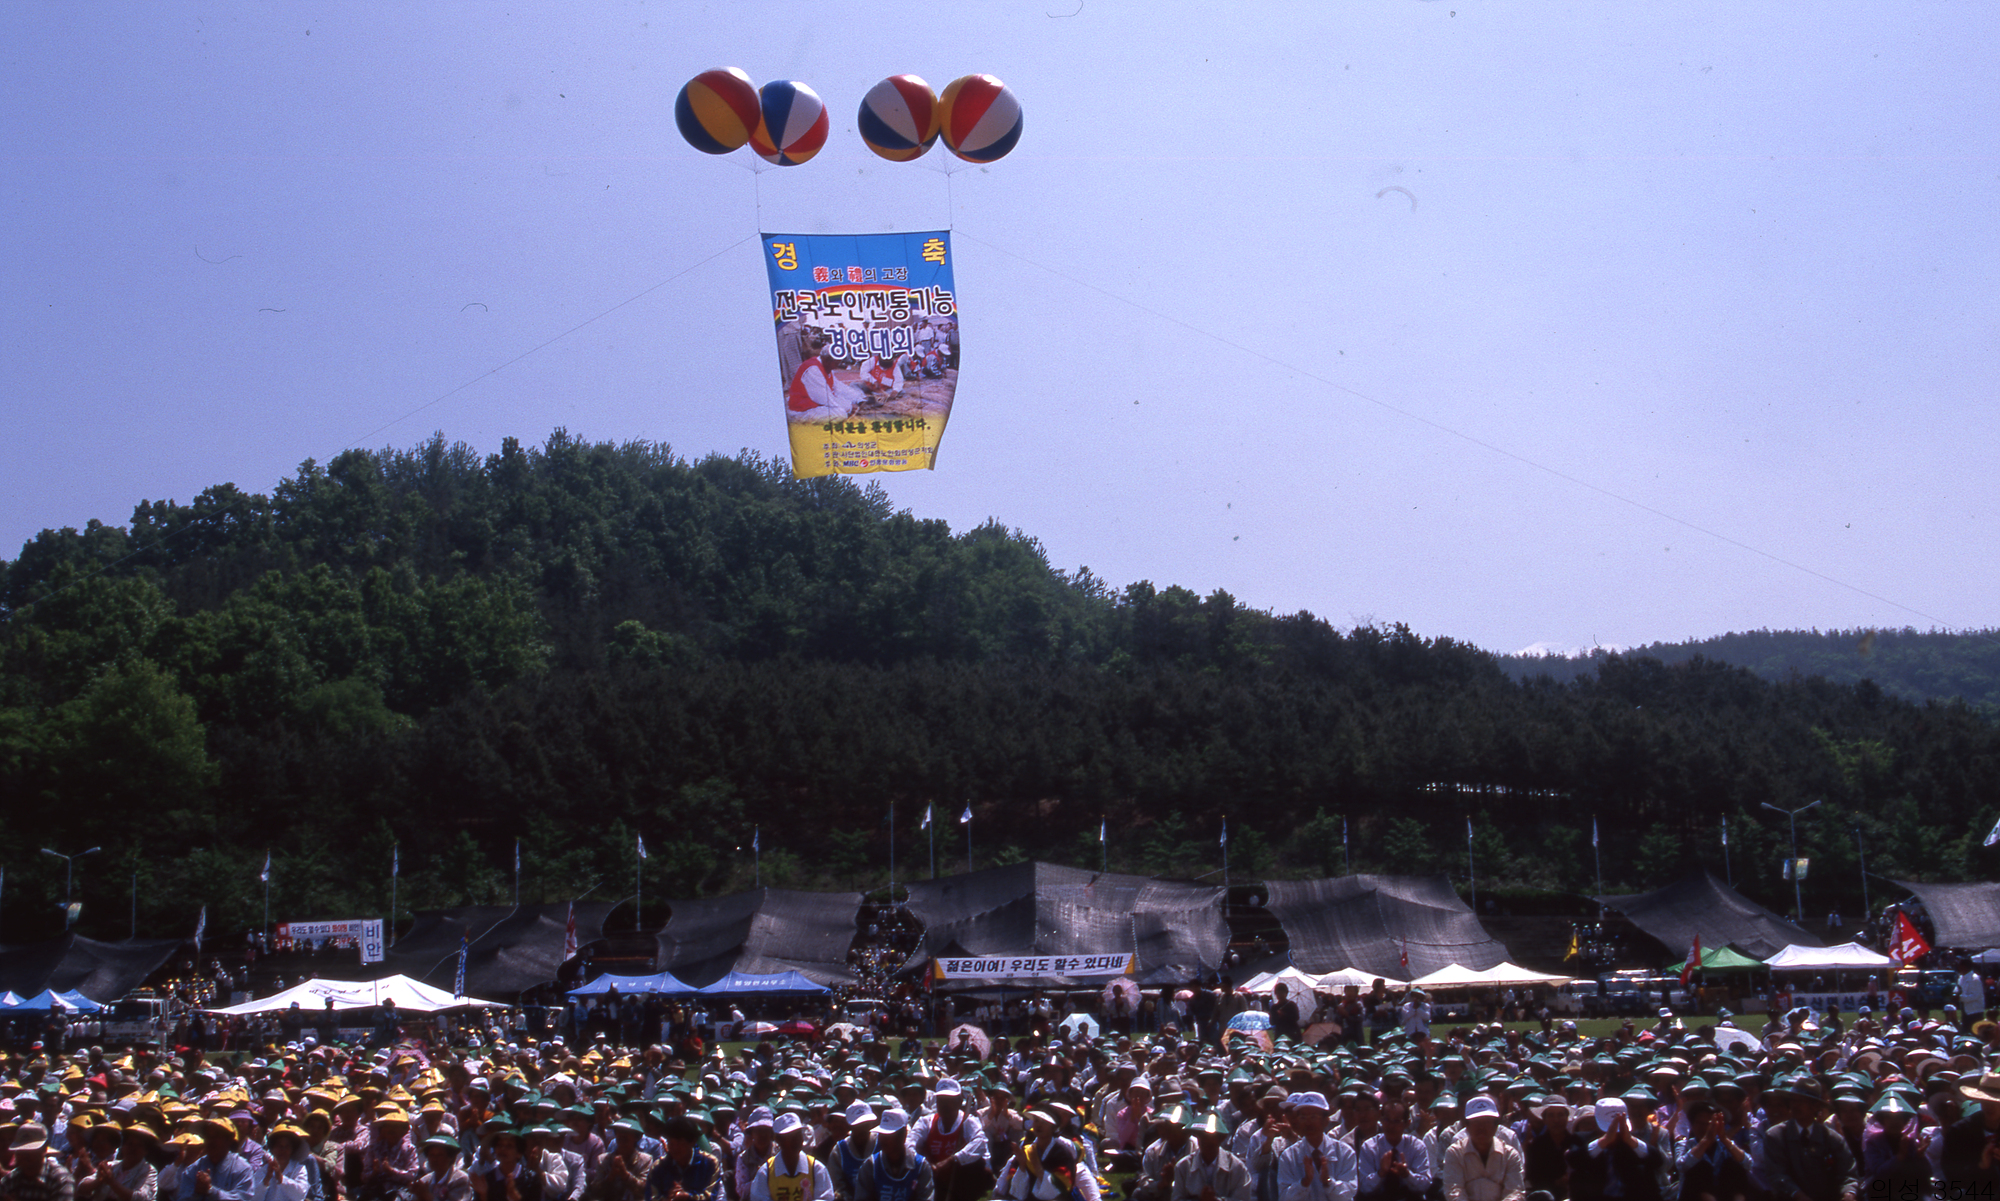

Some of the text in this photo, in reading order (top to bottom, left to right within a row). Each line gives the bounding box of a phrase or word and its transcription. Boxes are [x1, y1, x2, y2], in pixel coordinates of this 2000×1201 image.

[773, 238, 947, 270] 경 축
[882, 267, 908, 282] 고장
[775, 286, 954, 322] 전국노인전통기능
[825, 327, 916, 359] 경연대회
[824, 418, 930, 434] 여러분을 환영합니다.
[291, 926, 307, 934] 우리도
[366, 925, 382, 957] 비안
[947, 956, 1123, 972] 젊은이여! 우리도 할수 있다네
[930, 1138, 956, 1155] 금성
